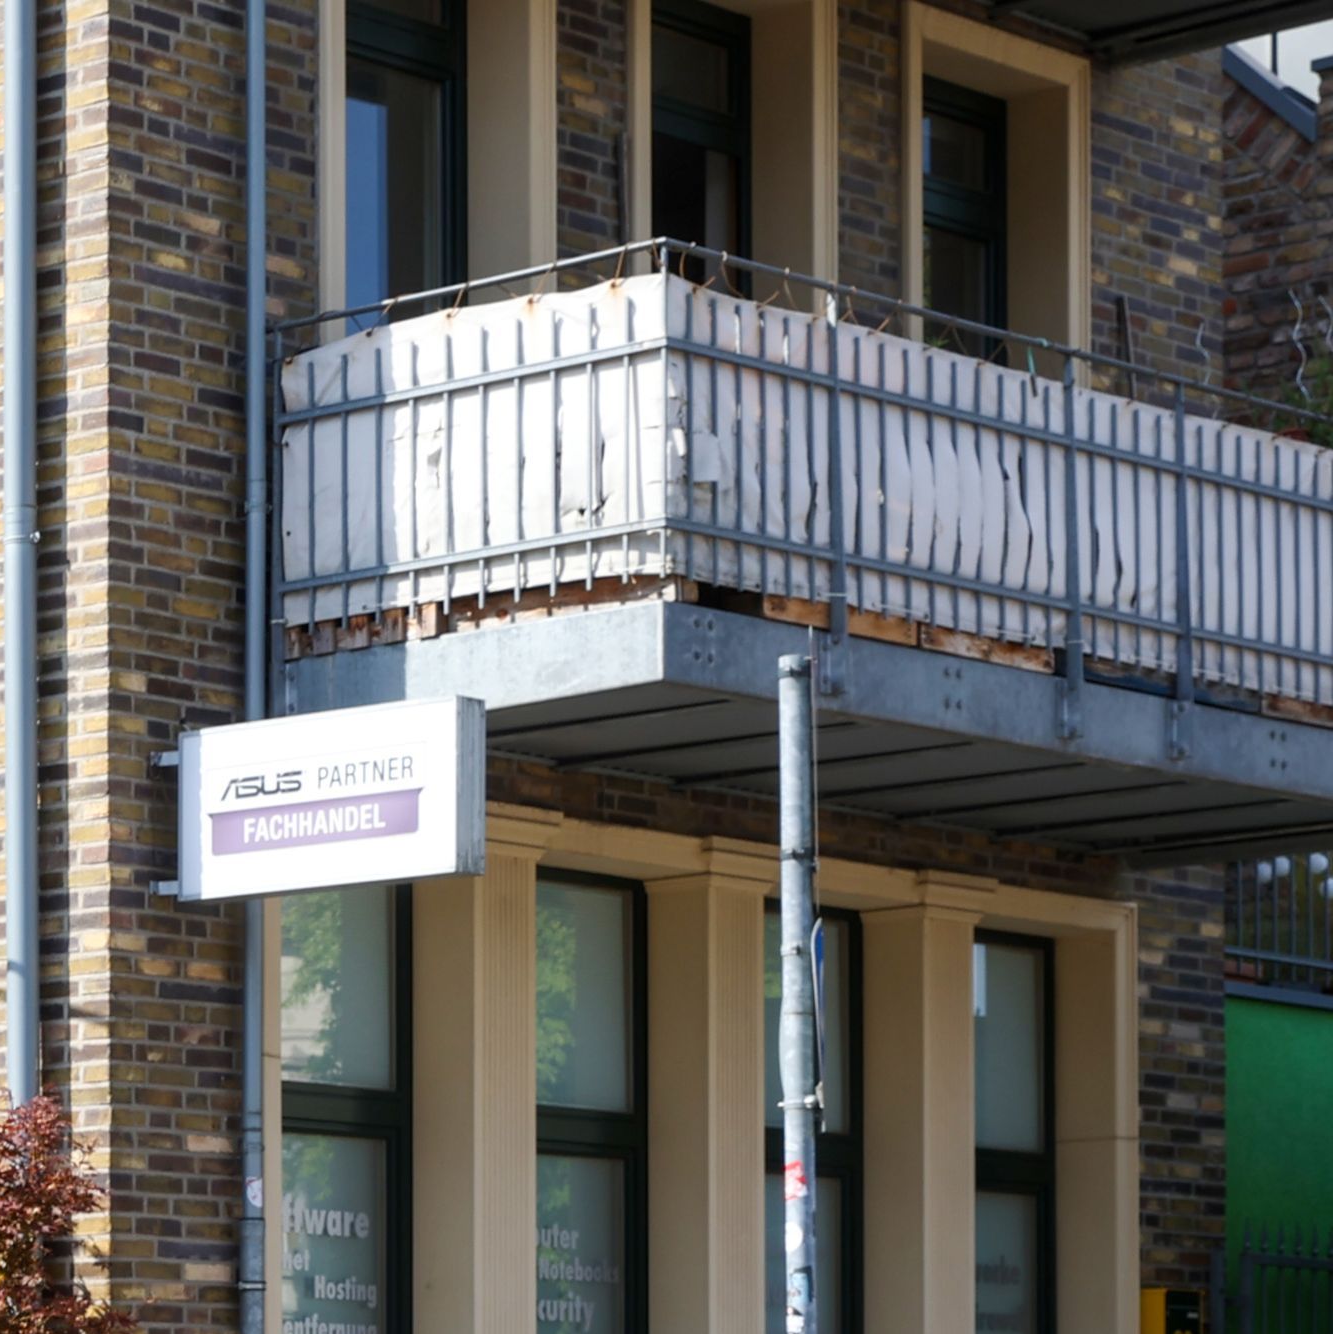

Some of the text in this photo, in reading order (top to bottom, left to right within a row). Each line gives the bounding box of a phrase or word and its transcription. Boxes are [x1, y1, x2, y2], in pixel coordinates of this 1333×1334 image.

[221, 755, 414, 801] ASUS PARTNER
[243, 803, 386, 844] FACHHANDEL
[538, 1257, 619, 1282] Notebooks
[314, 1275, 378, 1308] Hosting
